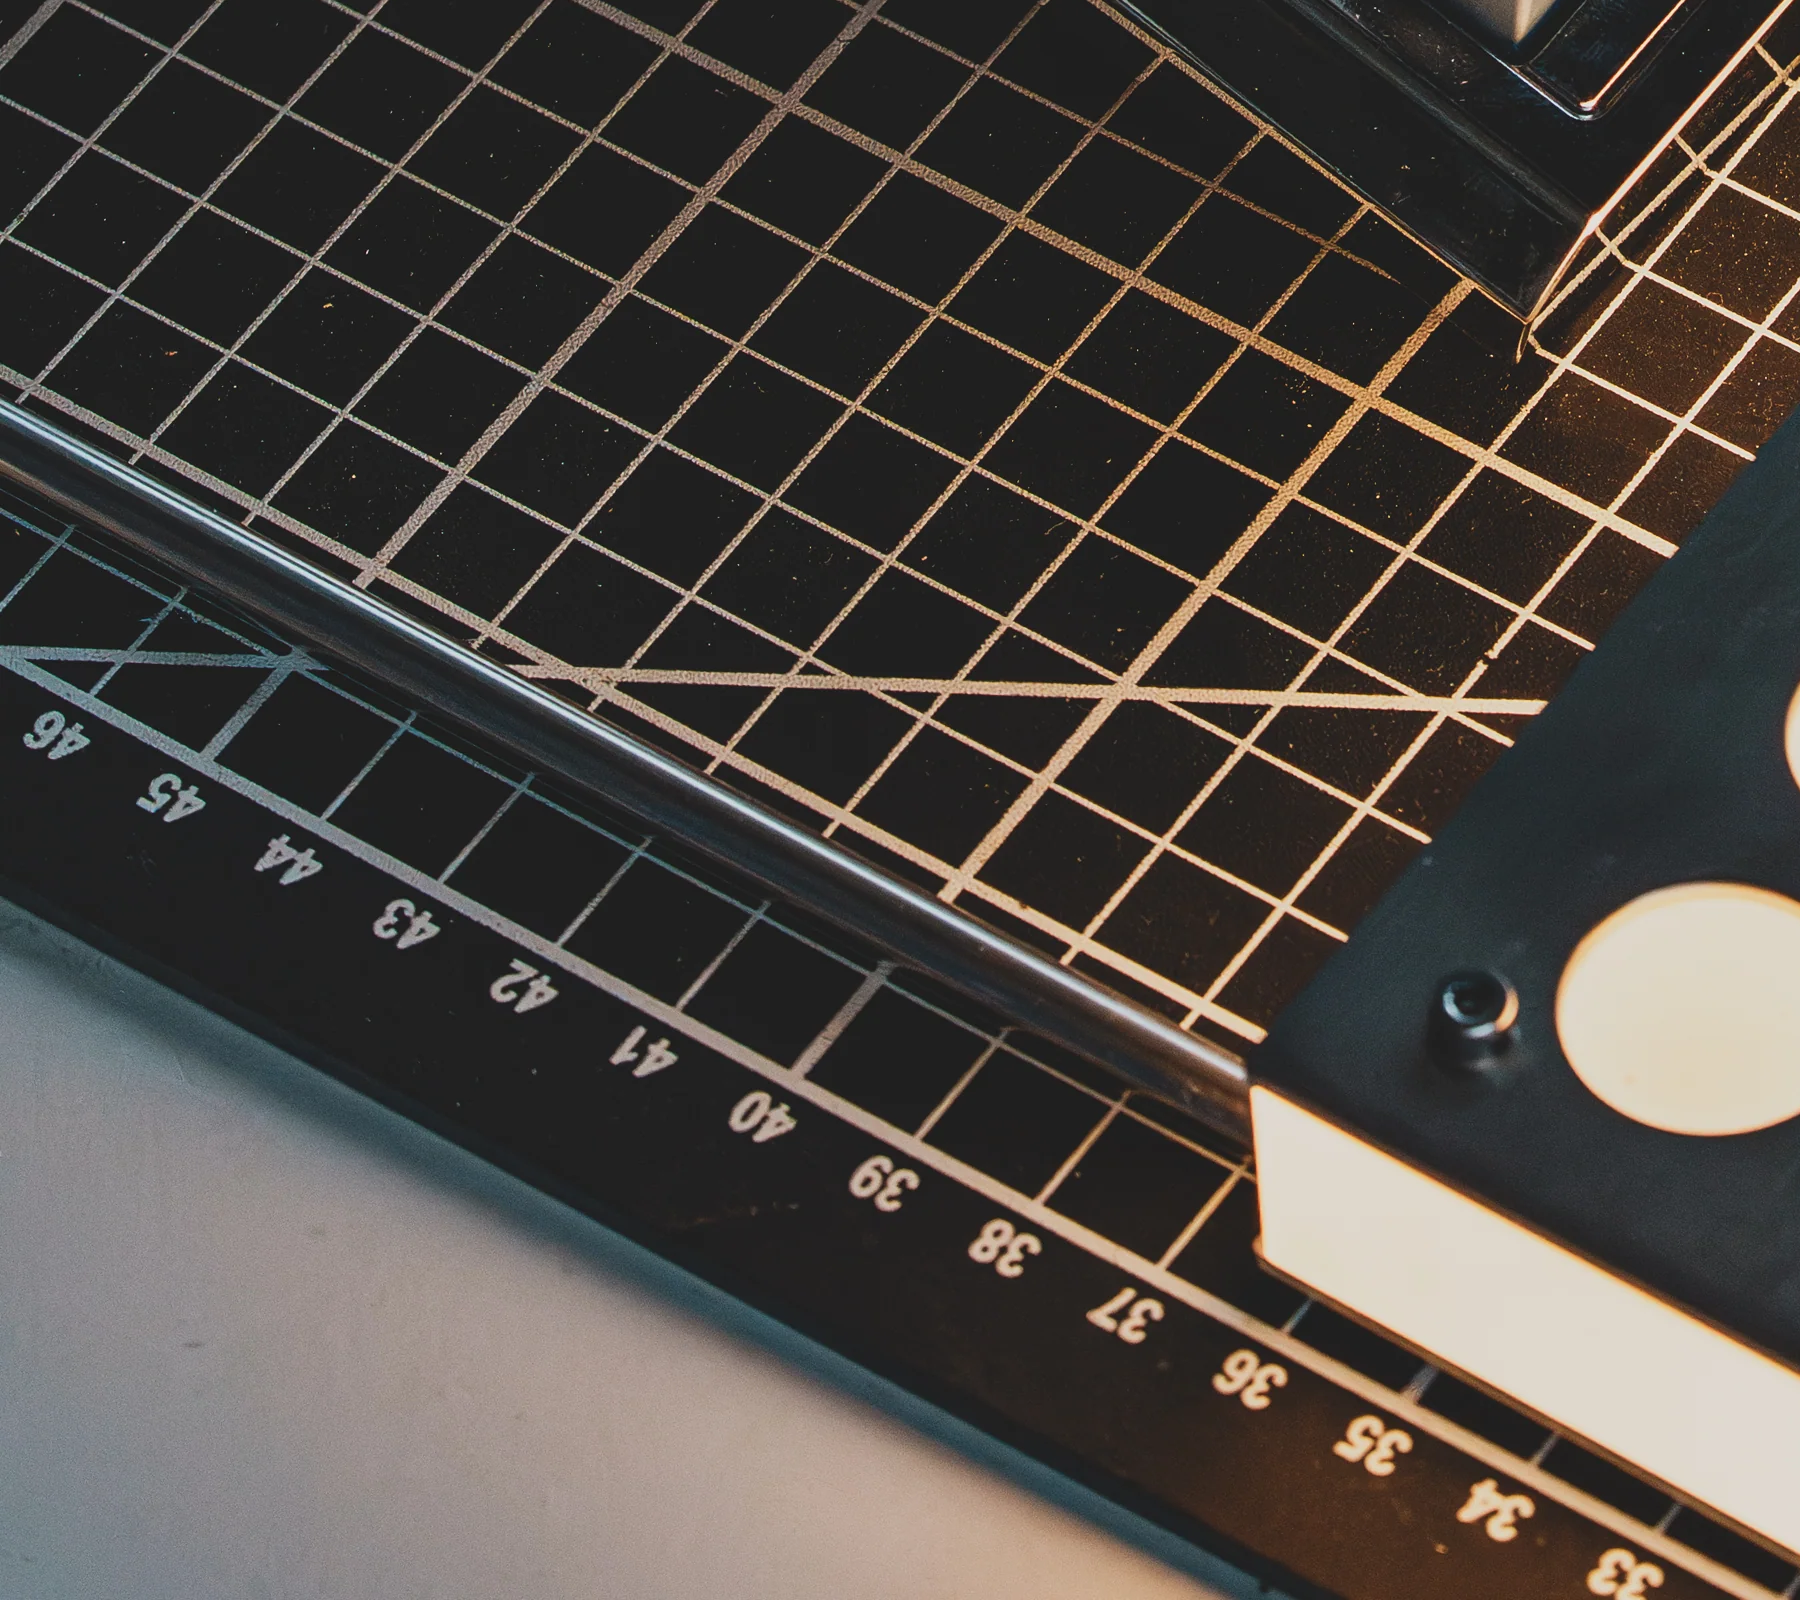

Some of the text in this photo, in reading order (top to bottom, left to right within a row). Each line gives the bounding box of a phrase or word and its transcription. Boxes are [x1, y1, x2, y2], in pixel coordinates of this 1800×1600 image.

[22, 710, 91, 761] 46
[135, 772, 207, 823] 45
[253, 834, 324, 886] 44
[372, 898, 441, 949] 43
[489, 958, 560, 1015] 42
[608, 1025, 679, 1079] 41
[727, 1090, 797, 1143] 40
[848, 1154, 920, 1213] 39
[967, 1218, 1042, 1278] 38
[1085, 1287, 1165, 1344] 37
[1211, 1349, 1289, 1410] 36
[1331, 1414, 1414, 1477] 35
[1455, 1478, 1536, 1542] 34
